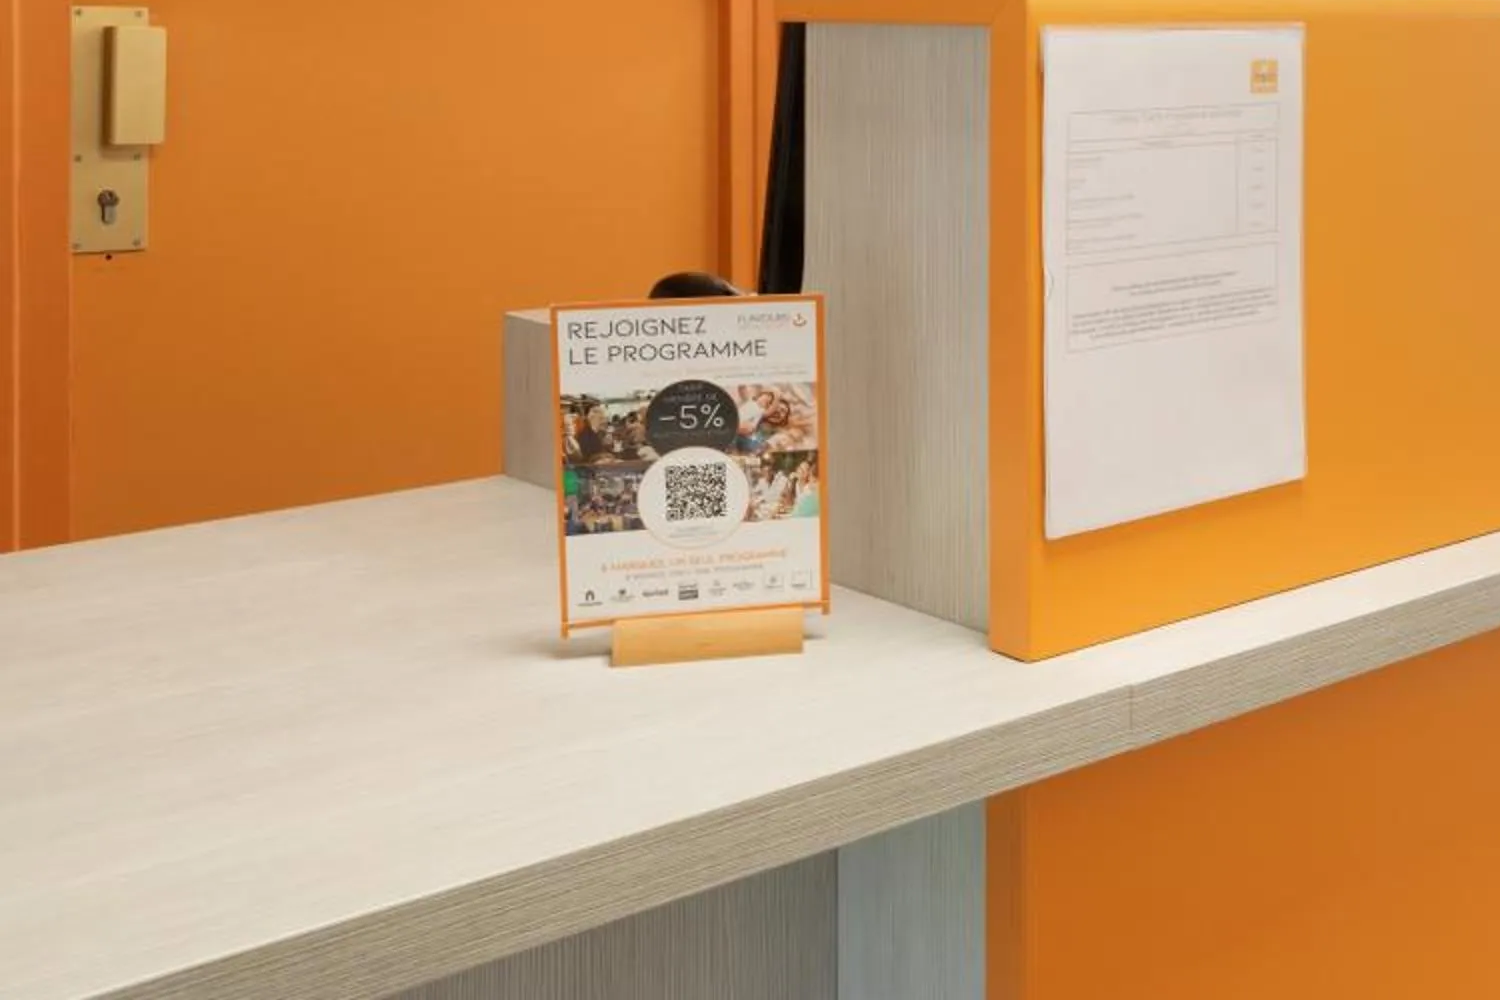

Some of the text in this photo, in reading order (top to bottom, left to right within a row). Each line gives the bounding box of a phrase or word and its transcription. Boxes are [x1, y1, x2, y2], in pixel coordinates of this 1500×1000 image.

[567, 316, 707, 340] REJOIGNEZ
[568, 339, 767, 366] LE PROGRAMME
